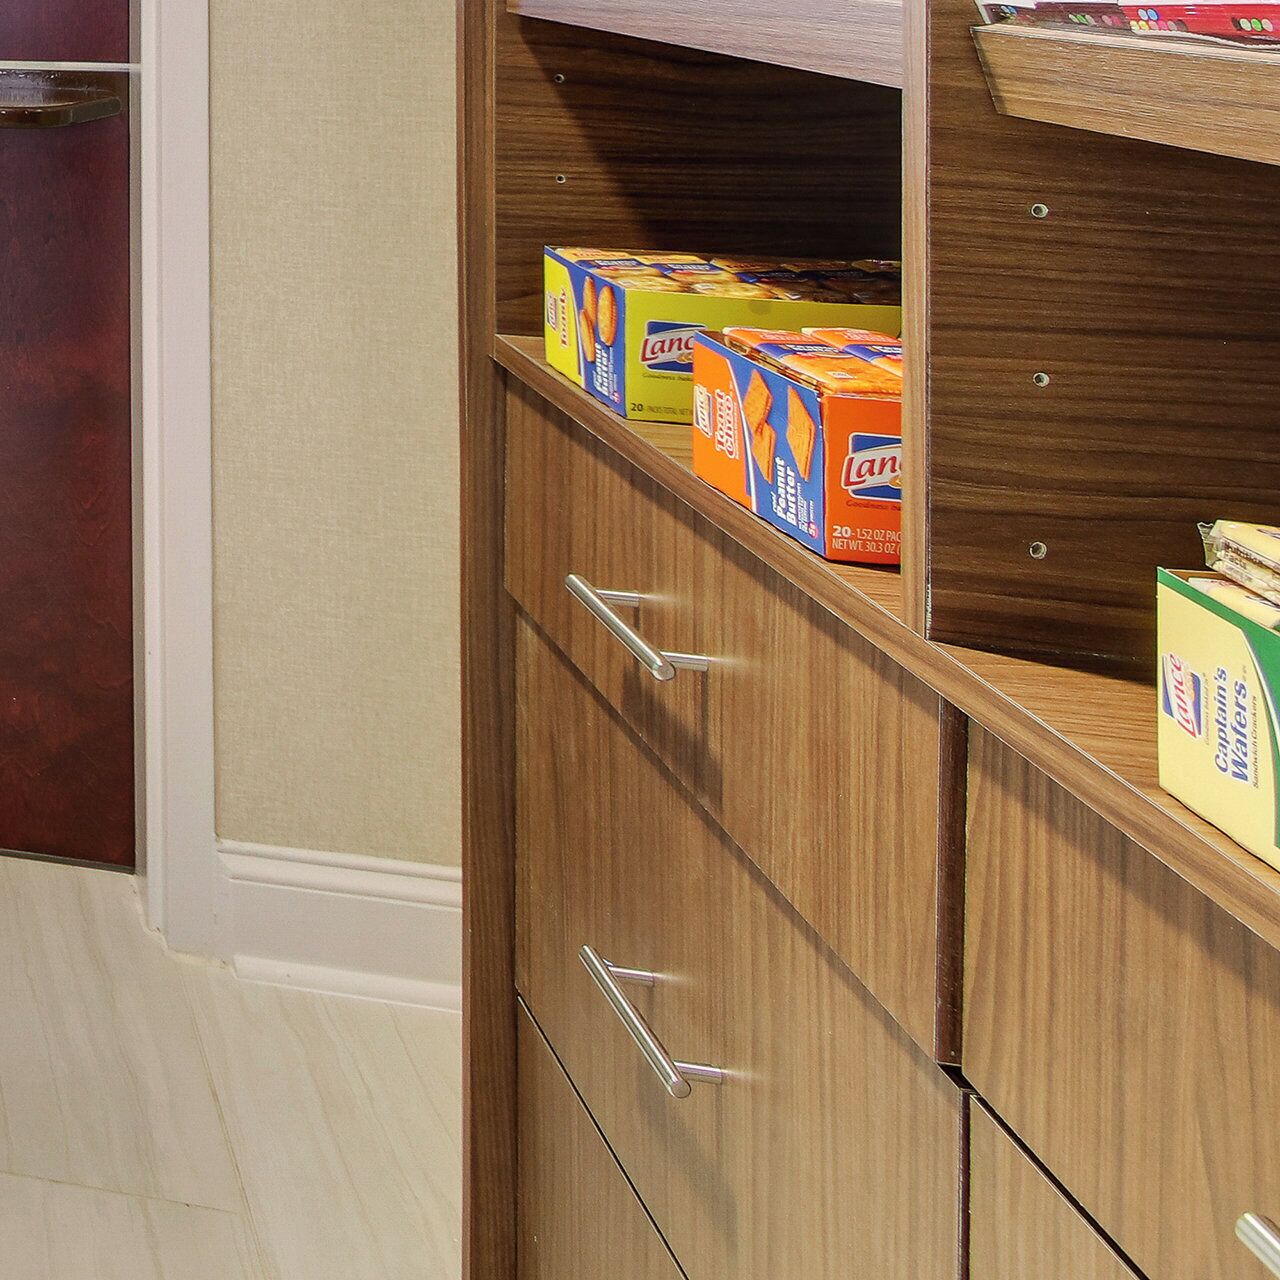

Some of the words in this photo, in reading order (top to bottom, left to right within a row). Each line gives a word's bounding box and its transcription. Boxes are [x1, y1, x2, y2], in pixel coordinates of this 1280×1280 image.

[559, 288, 569, 349] Toasty
[631, 403, 644, 412] 20
[714, 389, 726, 452] Toast
[723, 394, 737, 460] Chee
[774, 456, 786, 519] Peanut
[786, 465, 797, 526] Butter
[832, 538, 848, 550] NET
[865, 541, 883, 553] 30.3
[884, 542, 896, 554] OZ
[873, 529, 886, 541] OZ
[1169, 653, 1197, 738] Lance
[1213, 667, 1230, 774] Captain's
[1230, 680, 1249, 783] Wafers
[1251, 739, 1259, 789] Sandwich
